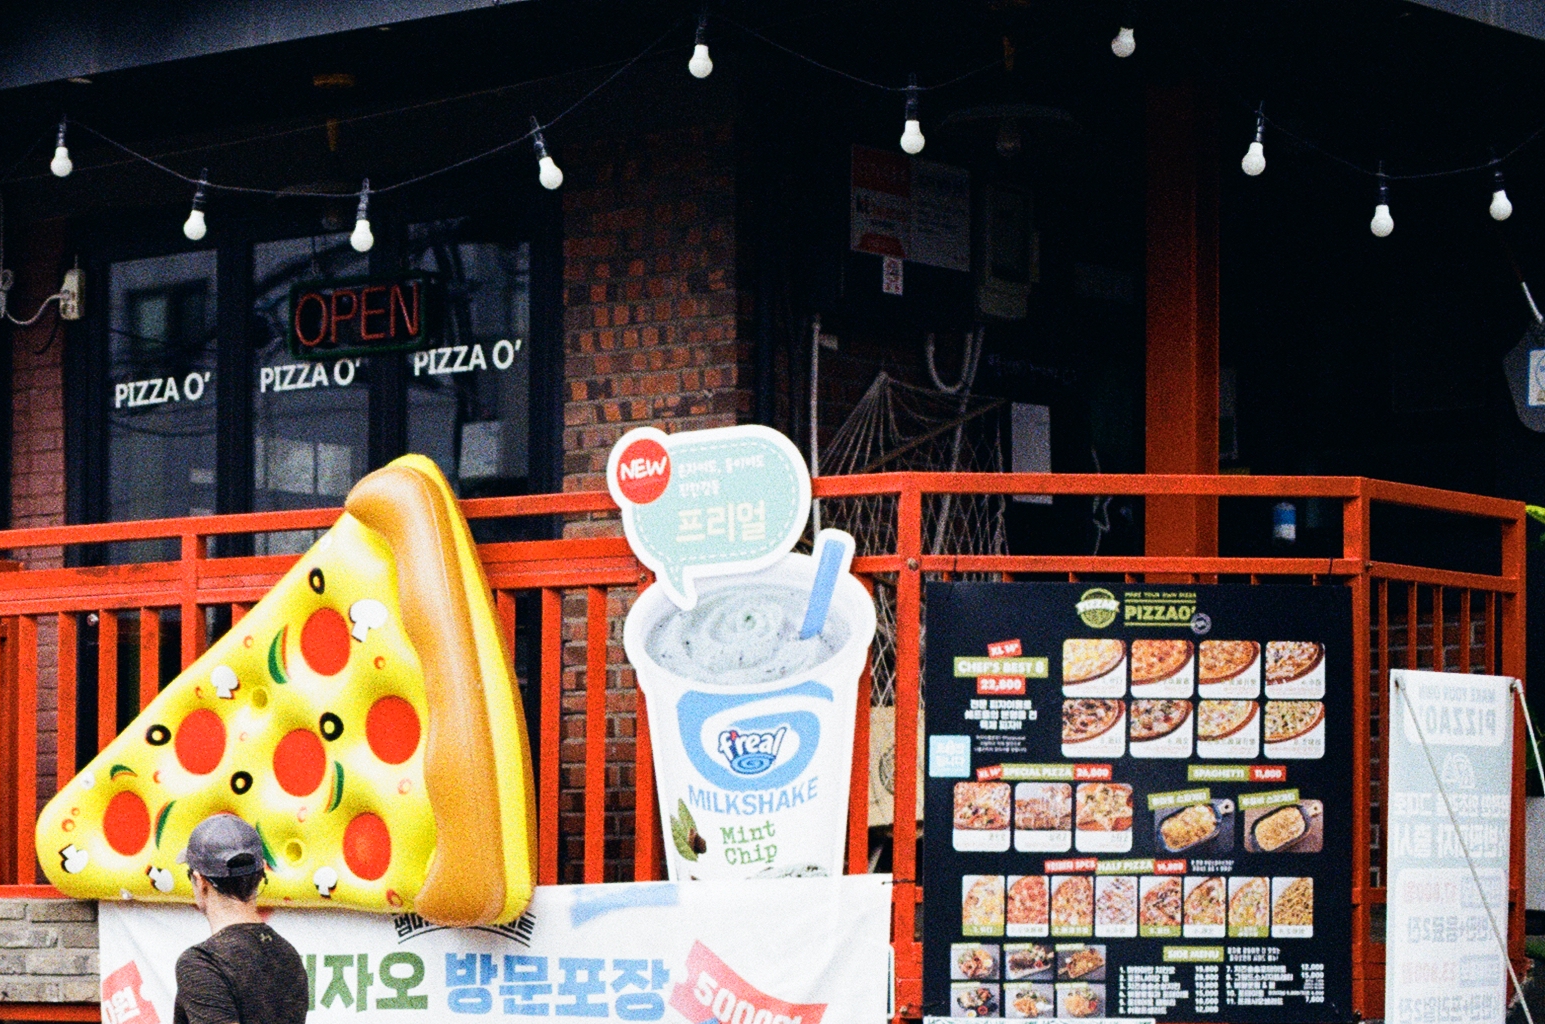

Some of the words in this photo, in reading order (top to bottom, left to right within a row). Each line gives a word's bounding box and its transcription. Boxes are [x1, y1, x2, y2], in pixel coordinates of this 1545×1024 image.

[294, 280, 420, 347] OPEN
[260, 362, 328, 393] PIZZA
[333, 357, 361, 387] O'
[413, 345, 487, 377] PIZZA
[492, 339, 523, 371] O'
[114, 378, 179, 409] PIZZA
[183, 372, 212, 401] O'
[619, 455, 668, 481] NEW
[676, 499, 766, 542] 프리얼
[1003, 661, 1033, 674] BEST
[718, 727, 788, 761] f'real
[1042, 768, 1072, 777] PIZZA
[1193, 769, 1244, 779] SPAGHETTI
[688, 776, 818, 815] MILKSHAKE
[719, 820, 776, 844] Mint
[724, 844, 777, 865] Chip
[1124, 862, 1154, 871] PIZZA
[445, 952, 671, 1022] 방문포장
